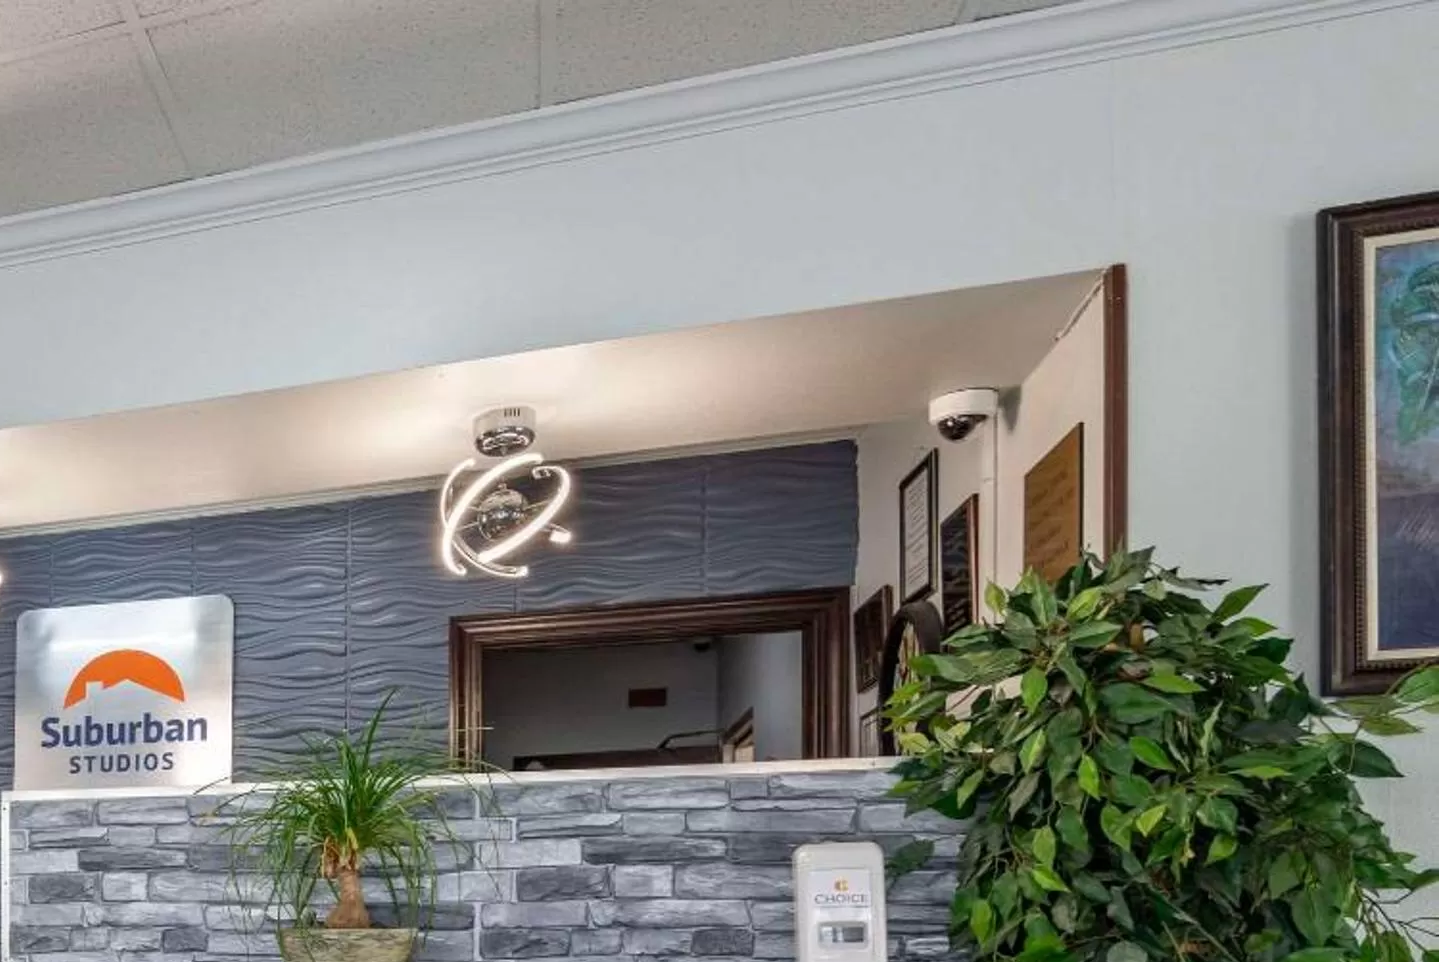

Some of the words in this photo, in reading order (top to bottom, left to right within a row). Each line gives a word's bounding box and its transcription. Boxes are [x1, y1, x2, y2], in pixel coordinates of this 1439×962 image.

[40, 711, 208, 749] Suburban
[68, 751, 175, 775] STUDIOS
[814, 893, 869, 905] CHOICE
